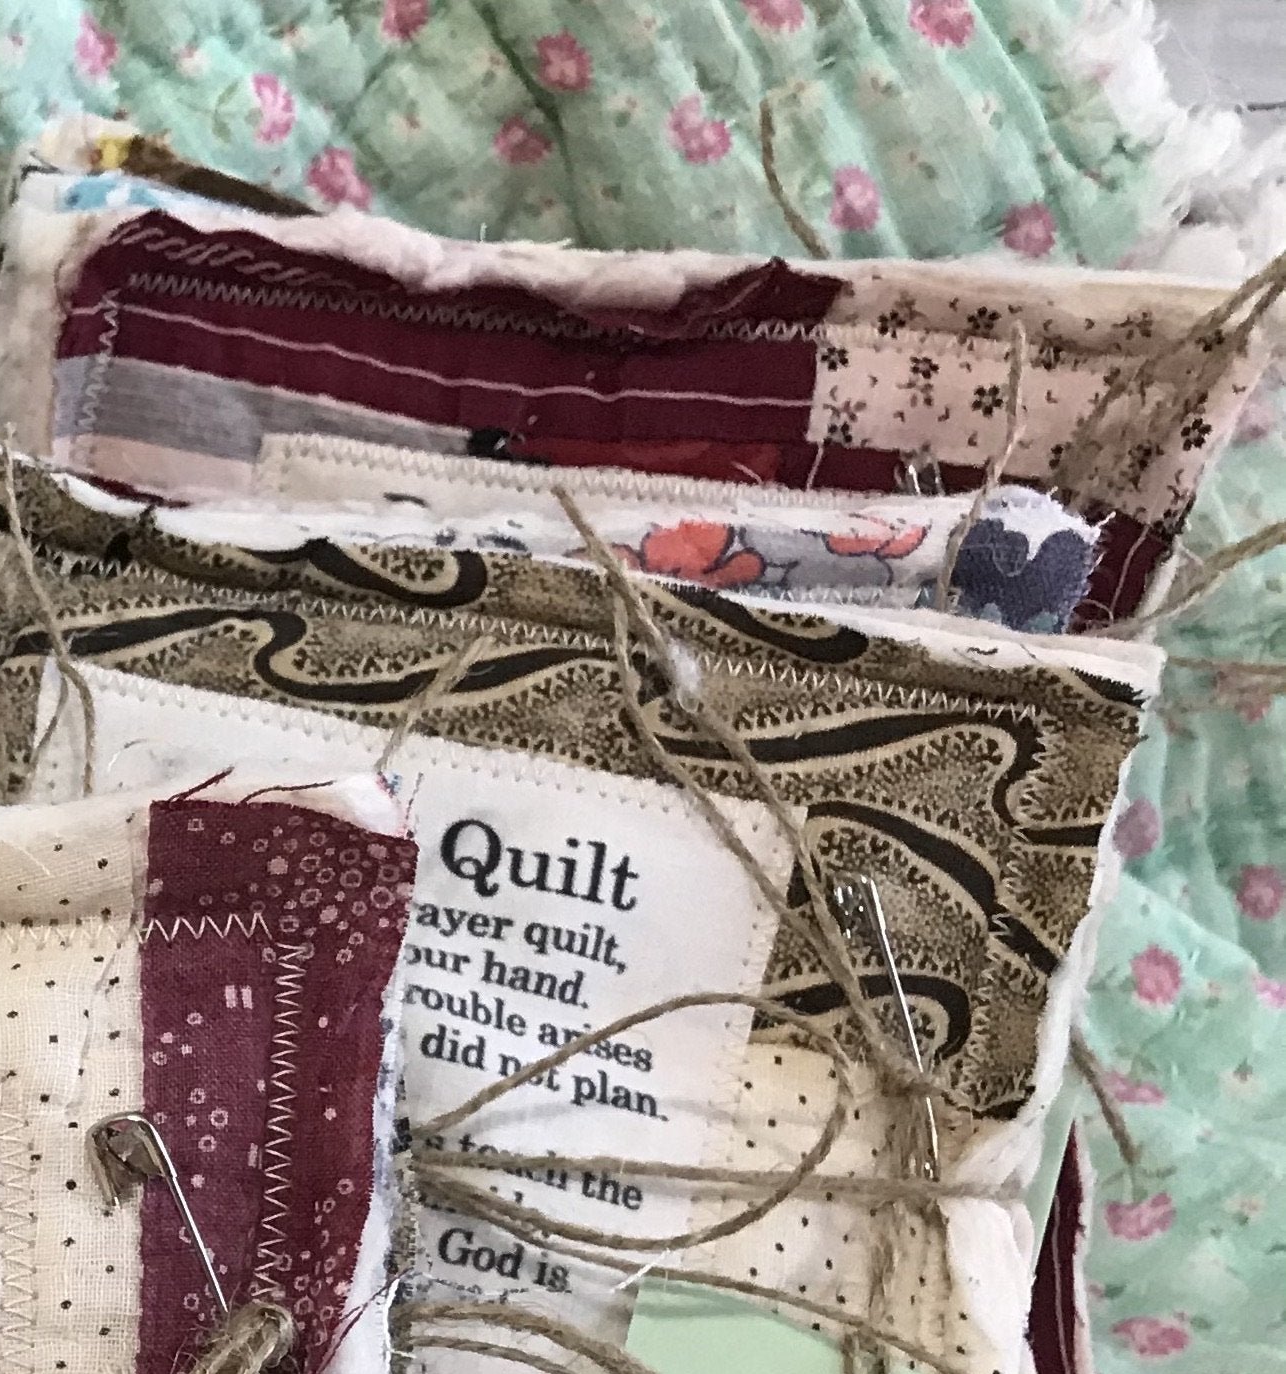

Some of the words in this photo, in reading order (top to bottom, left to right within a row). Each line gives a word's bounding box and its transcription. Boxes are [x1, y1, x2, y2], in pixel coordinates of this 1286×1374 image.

[440, 819, 639, 911] Quilt
[410, 902, 513, 940] ayer
[524, 922, 626, 974] quilt,
[404, 984, 526, 1036] rouble
[482, 950, 588, 1009] hand.
[420, 1023, 485, 1070] did
[572, 1070, 668, 1121] plan.
[438, 1228, 524, 1279] God
